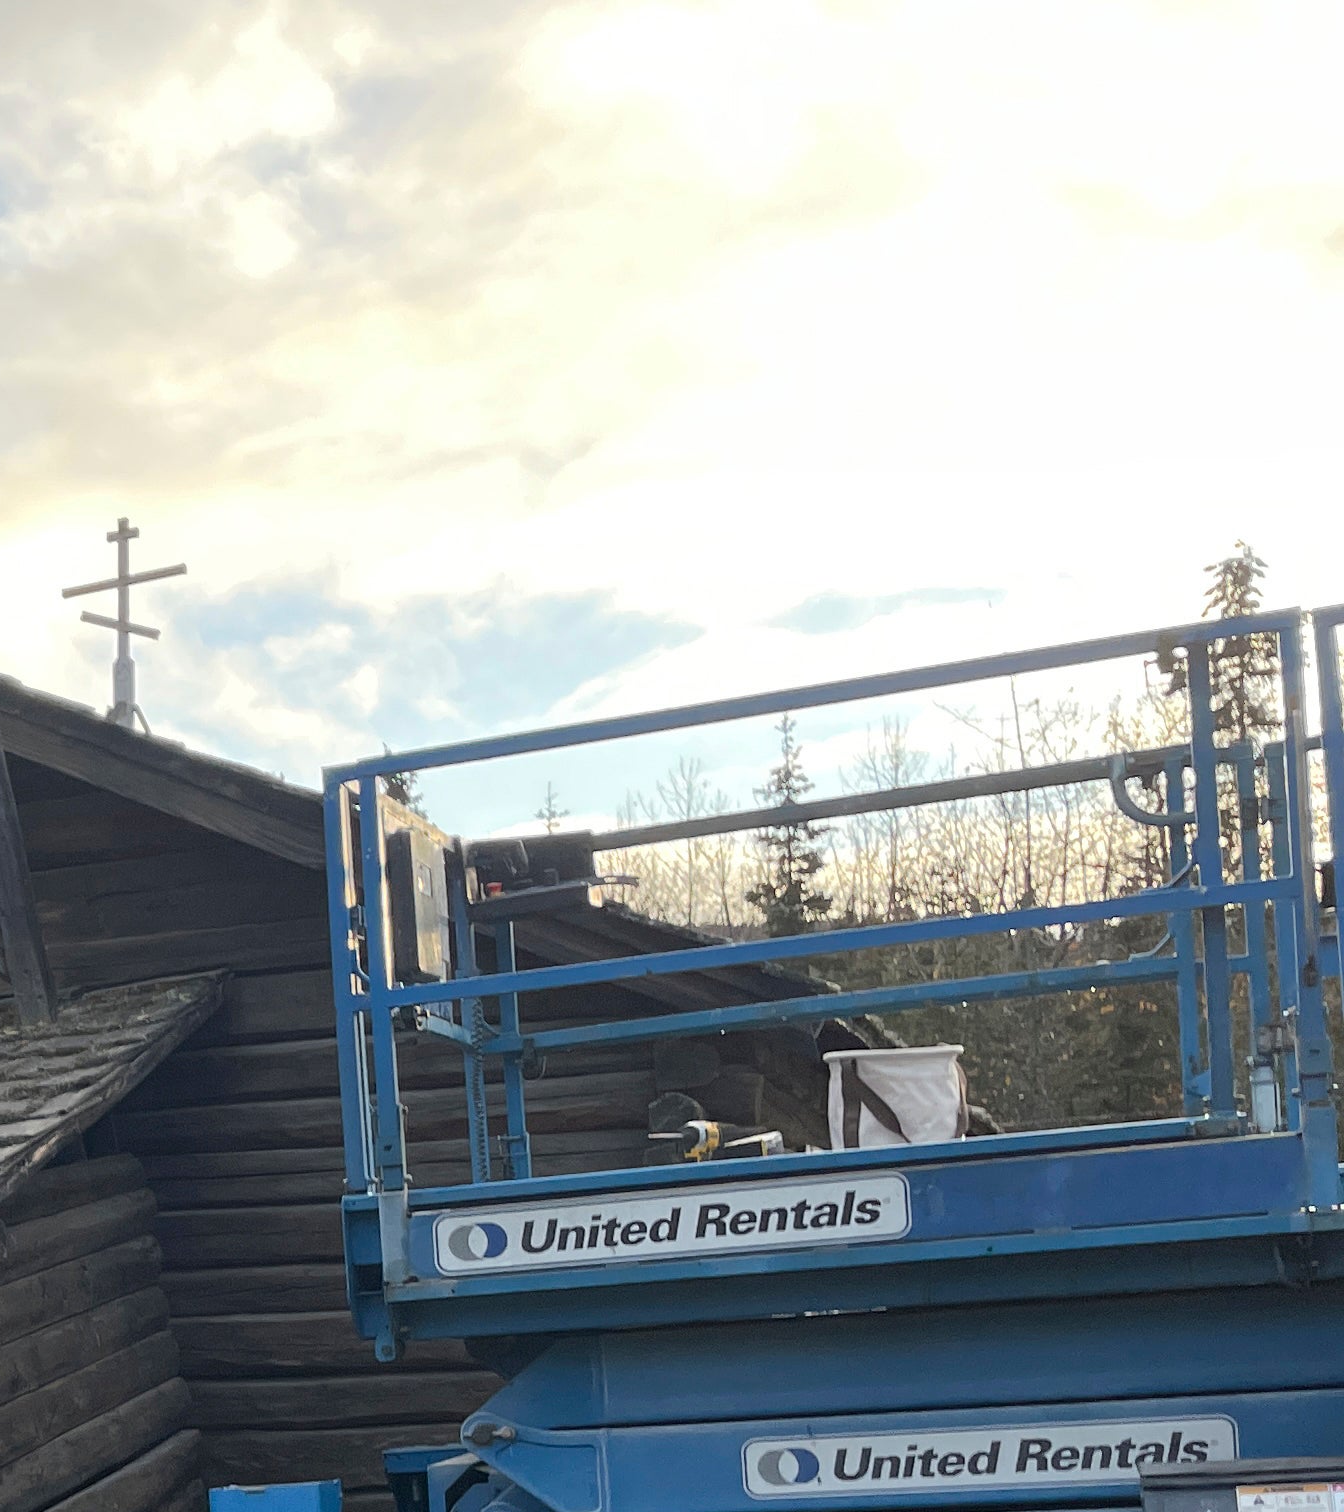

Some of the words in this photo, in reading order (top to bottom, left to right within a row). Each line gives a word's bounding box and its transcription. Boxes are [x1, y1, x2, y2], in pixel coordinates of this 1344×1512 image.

[520, 1206, 682, 1254] United
[694, 1190, 882, 1240] Rentals
[833, 1440, 1001, 1482] United
[1014, 1431, 1210, 1473] Rentals
